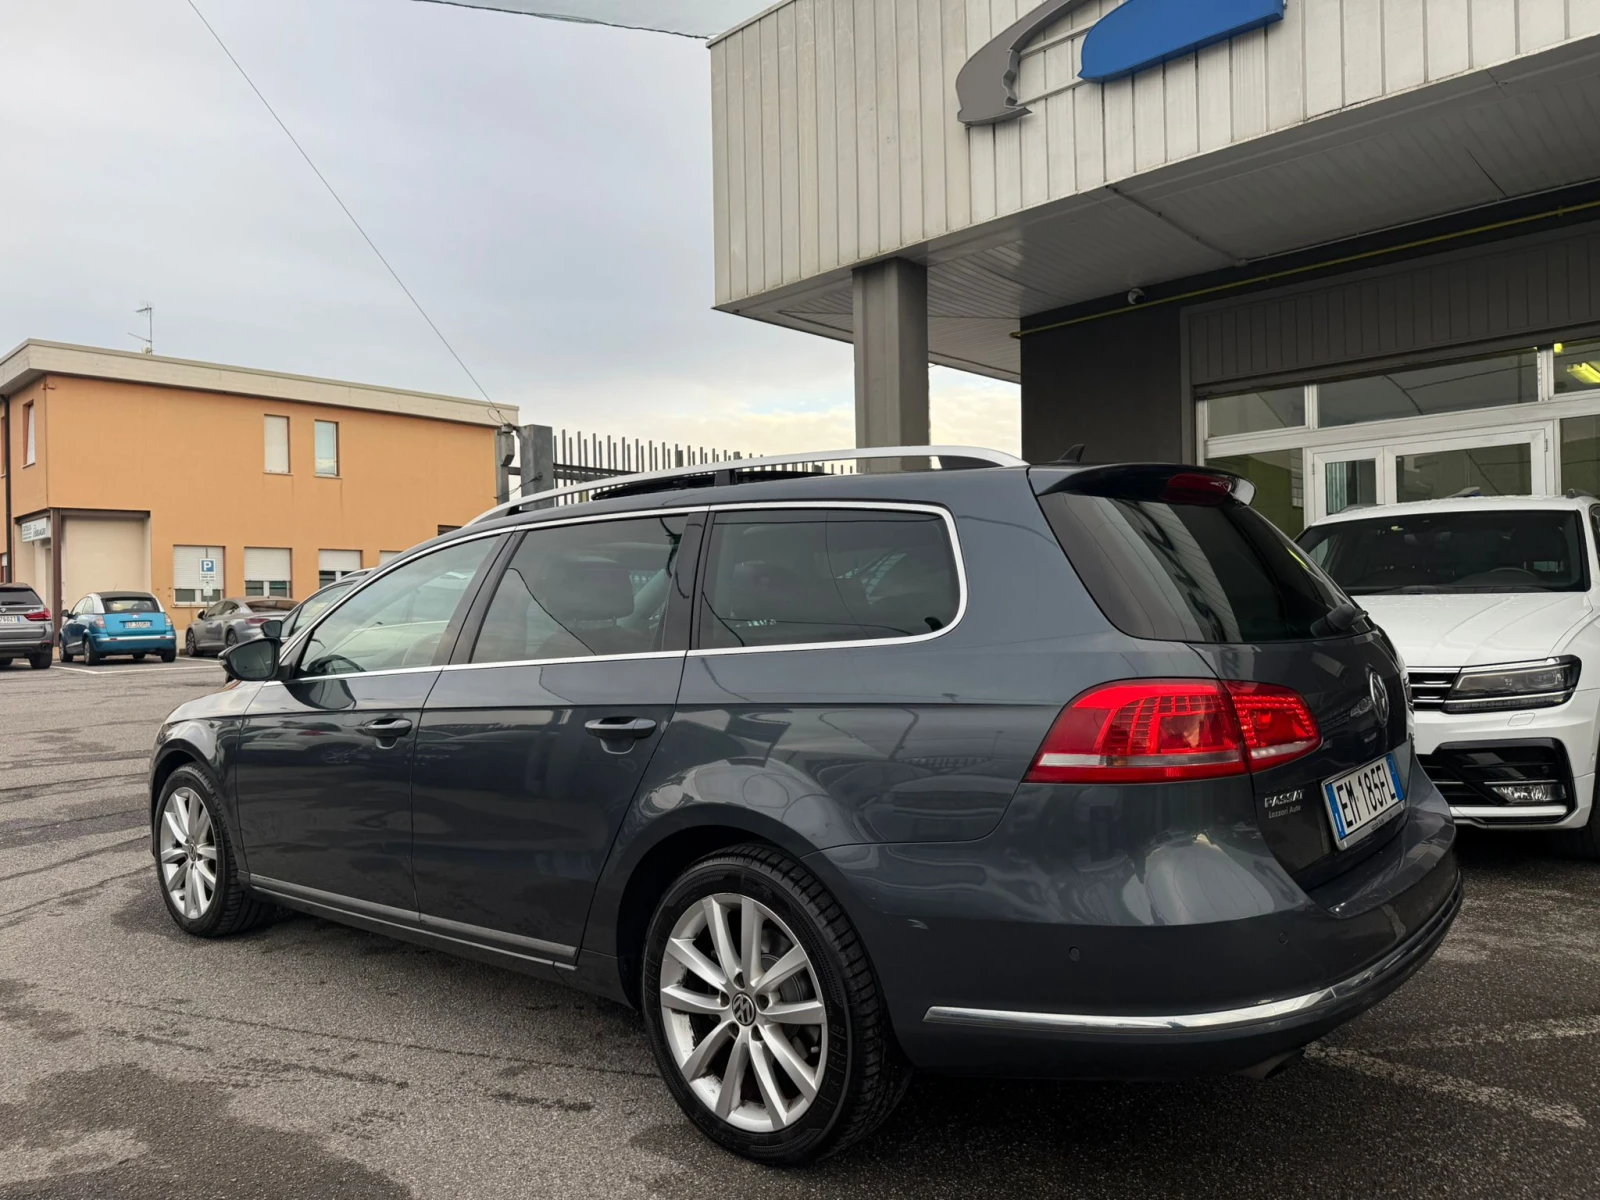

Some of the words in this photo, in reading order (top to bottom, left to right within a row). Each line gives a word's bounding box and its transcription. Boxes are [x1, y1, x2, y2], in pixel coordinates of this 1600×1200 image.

[1264, 789, 1304, 808] PASSAT
[1336, 780, 1361, 828] EM
[1358, 763, 1396, 815] 185FL
